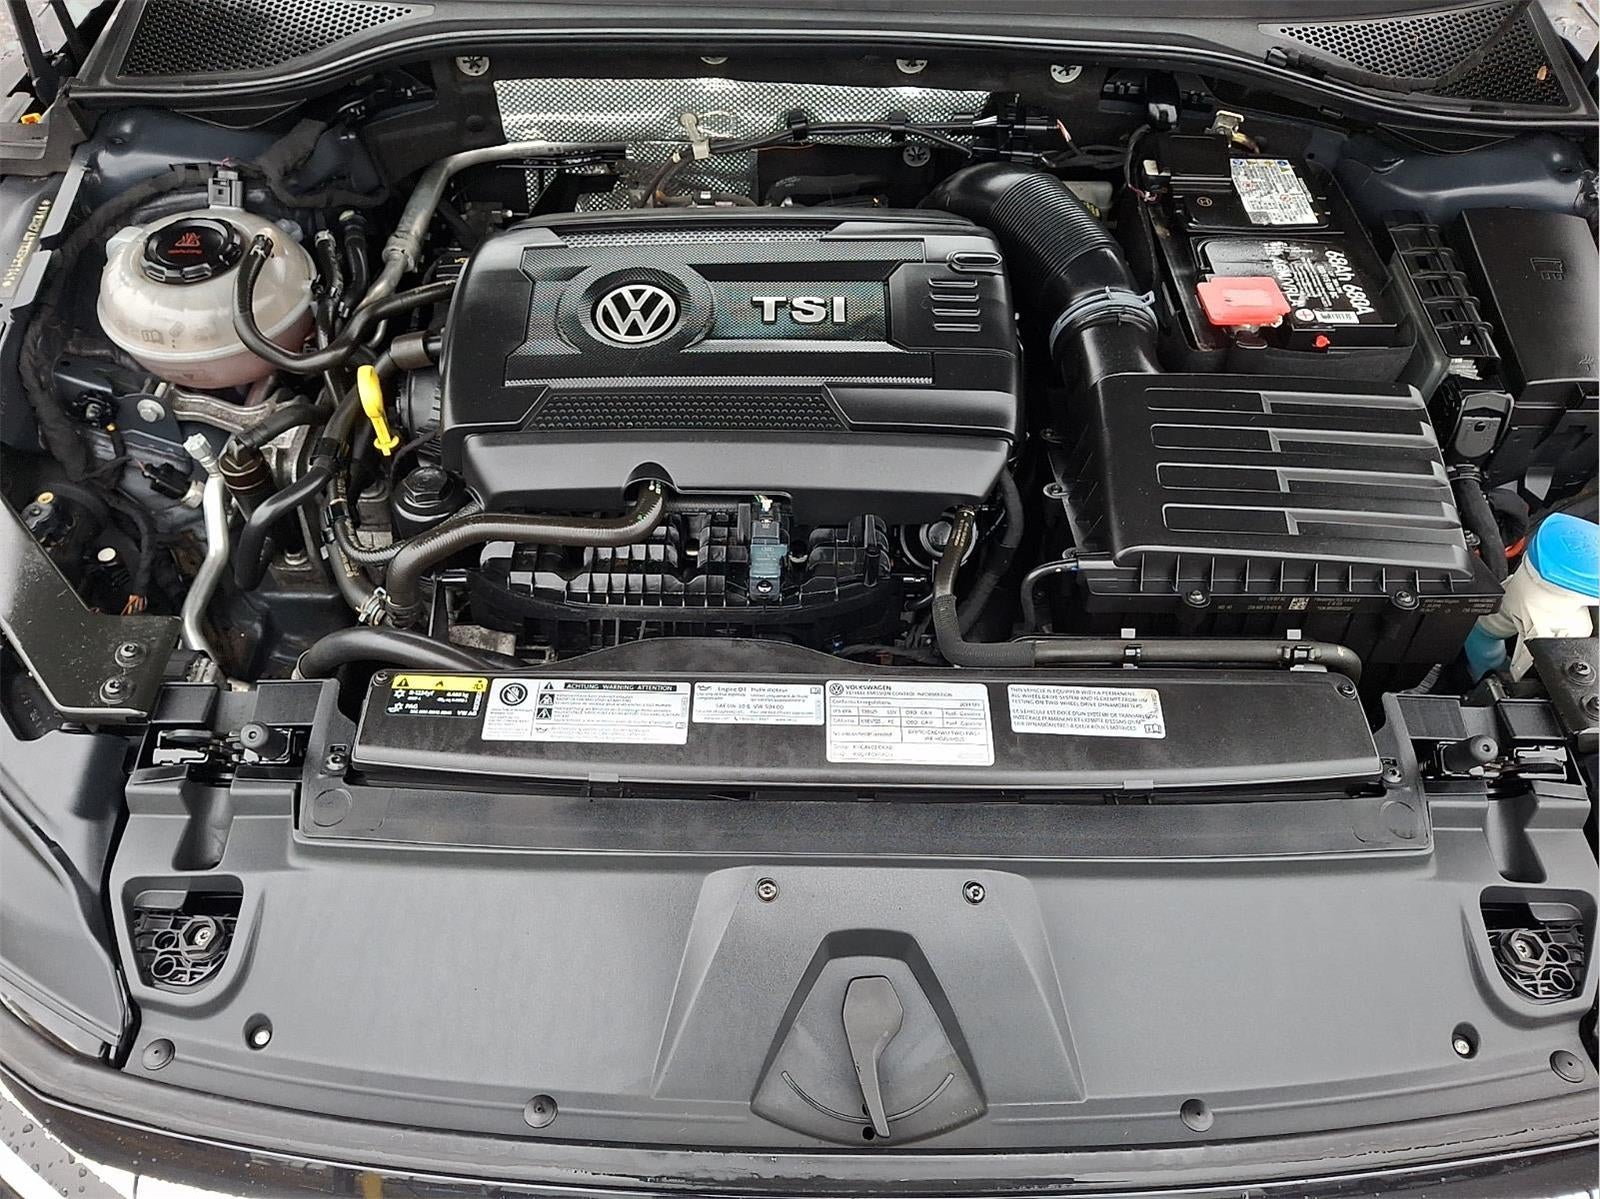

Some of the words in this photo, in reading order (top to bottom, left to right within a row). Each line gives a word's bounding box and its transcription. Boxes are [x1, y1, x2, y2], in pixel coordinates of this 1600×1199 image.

[1325, 250, 1356, 282] 68Ah
[1342, 284, 1375, 316] 680A
[752, 296, 847, 324] TSI
